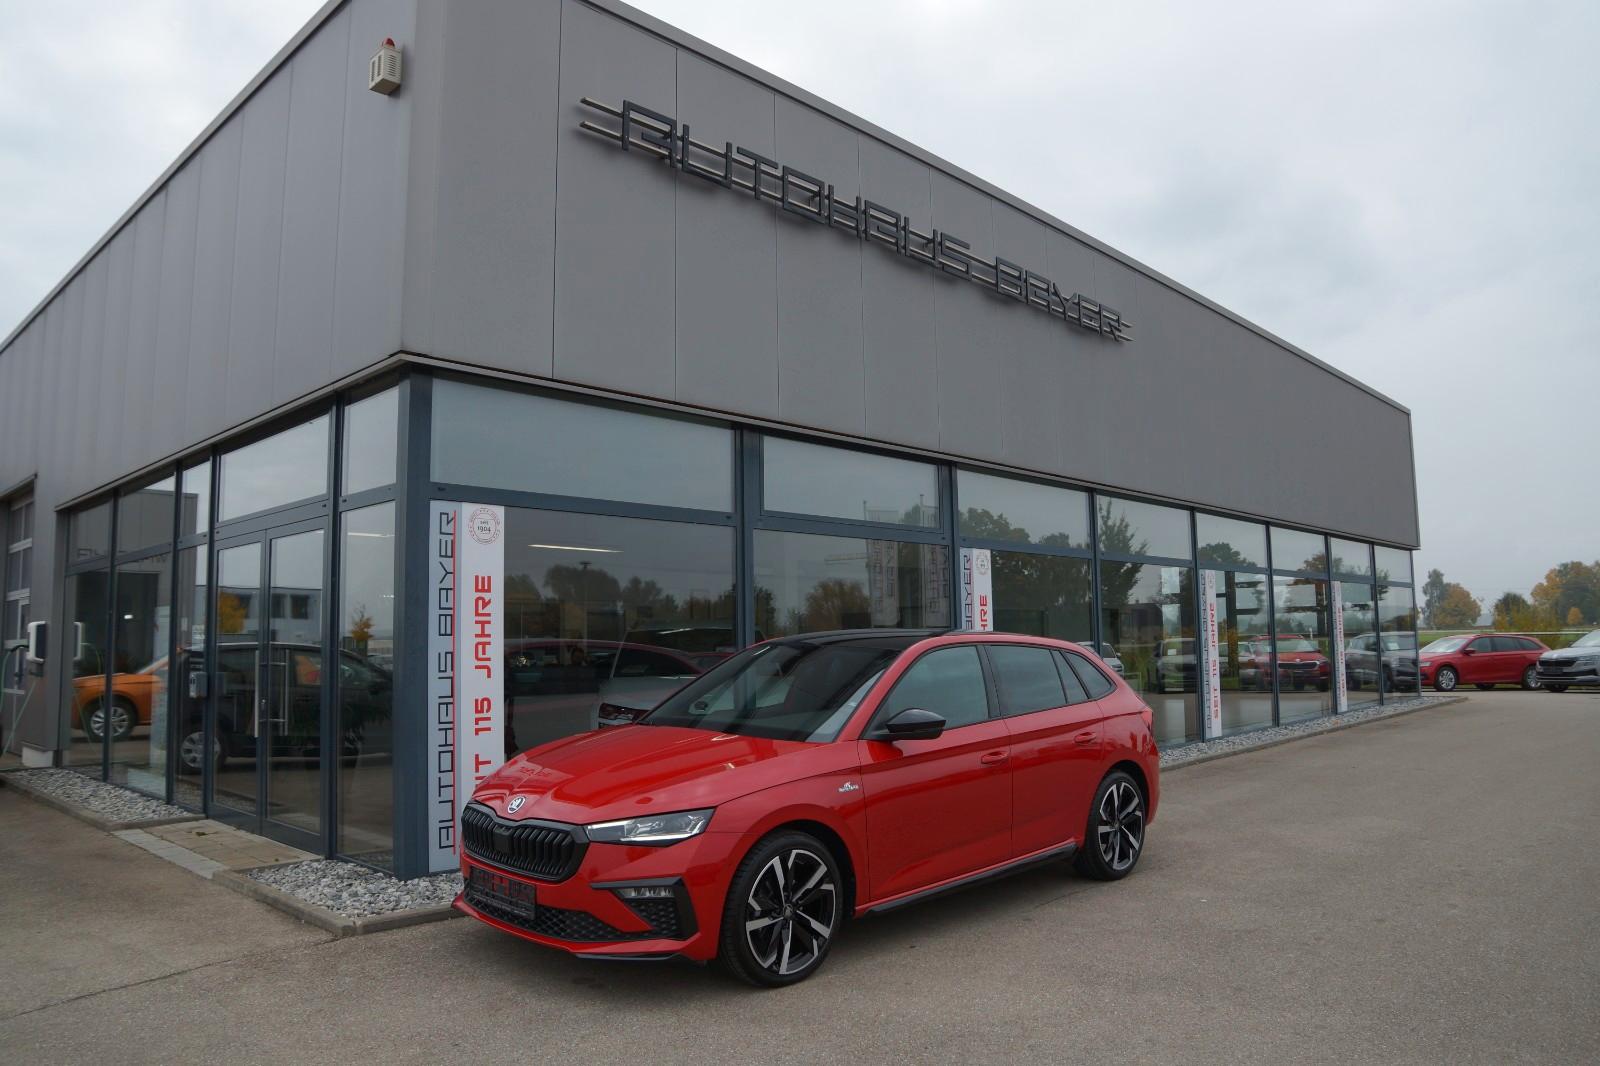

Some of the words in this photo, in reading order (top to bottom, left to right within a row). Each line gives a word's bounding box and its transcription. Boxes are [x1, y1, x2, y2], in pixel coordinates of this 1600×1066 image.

[622, 100, 972, 281] AUTOHAUS
[995, 256, 1122, 342] BAYER
[438, 512, 454, 636] BAYER
[474, 575, 492, 679] JAHRE
[438, 651, 455, 849] AUTOHAUS
[474, 697, 492, 736] 115
